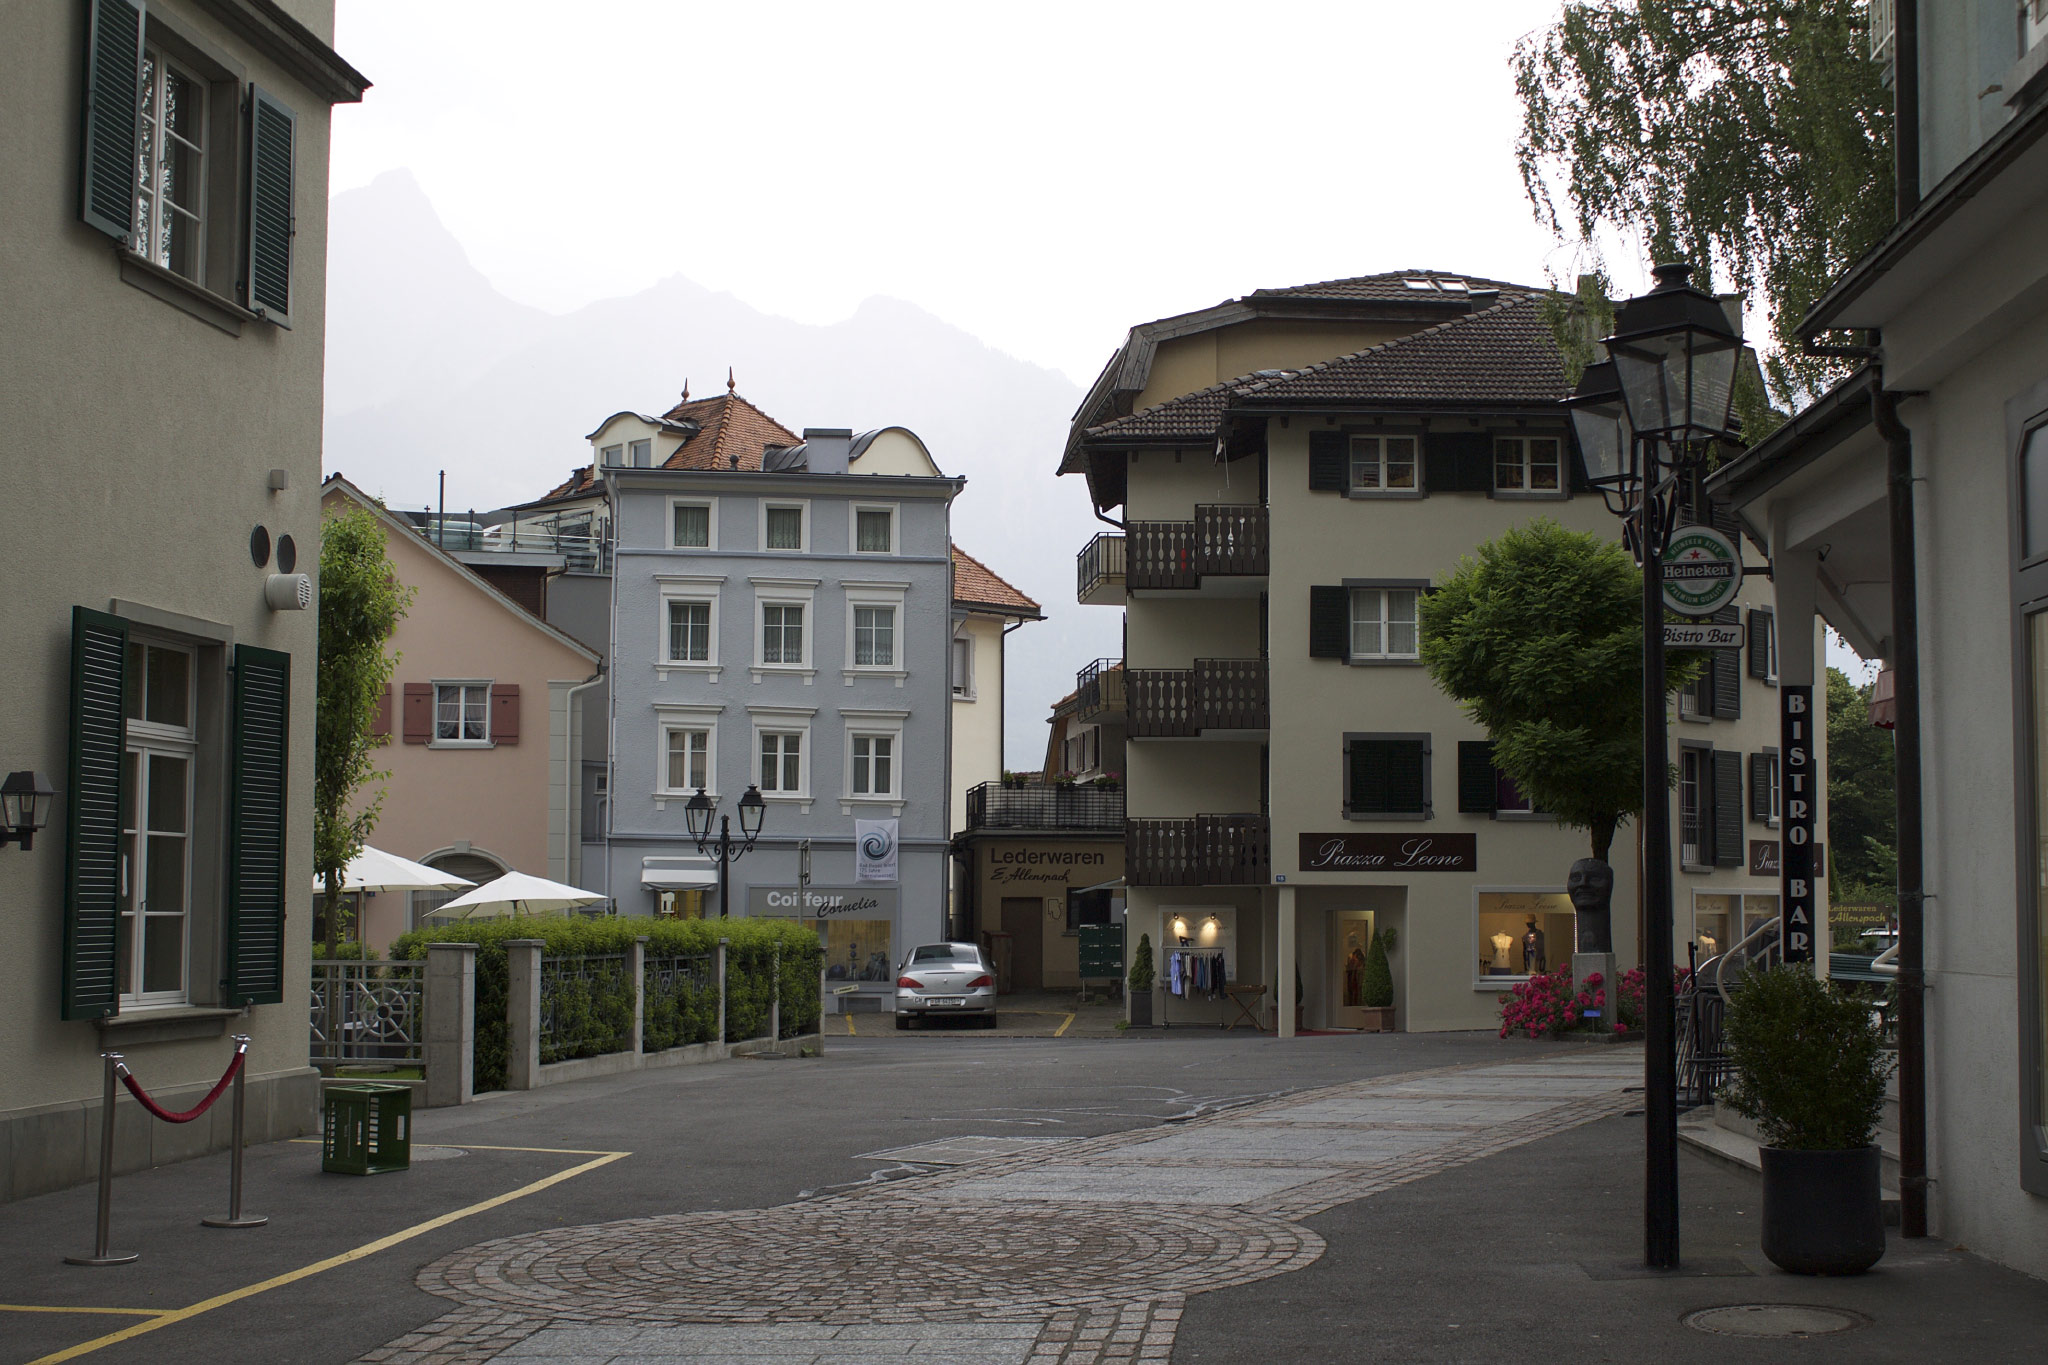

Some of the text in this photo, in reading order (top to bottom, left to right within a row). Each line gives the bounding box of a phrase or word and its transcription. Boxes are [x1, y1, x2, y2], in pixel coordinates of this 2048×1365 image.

[1663, 564, 1729, 578] Heineken
[1669, 586, 1699, 603] PREMIUM
[1701, 584, 1725, 603] QUALITY
[1663, 628, 1736, 643] Bistro Bar
[1788, 694, 1808, 951] BISTRO BAR
[990, 848, 1105, 865] Lederwaren
[1311, 838, 1464, 867] Piazza Leone
[767, 891, 843, 907] Coifeur
[816, 897, 879, 919] Cornelia
[1828, 904, 1877, 912] Lederwaren
[1828, 911, 1887, 925] Allenspach
